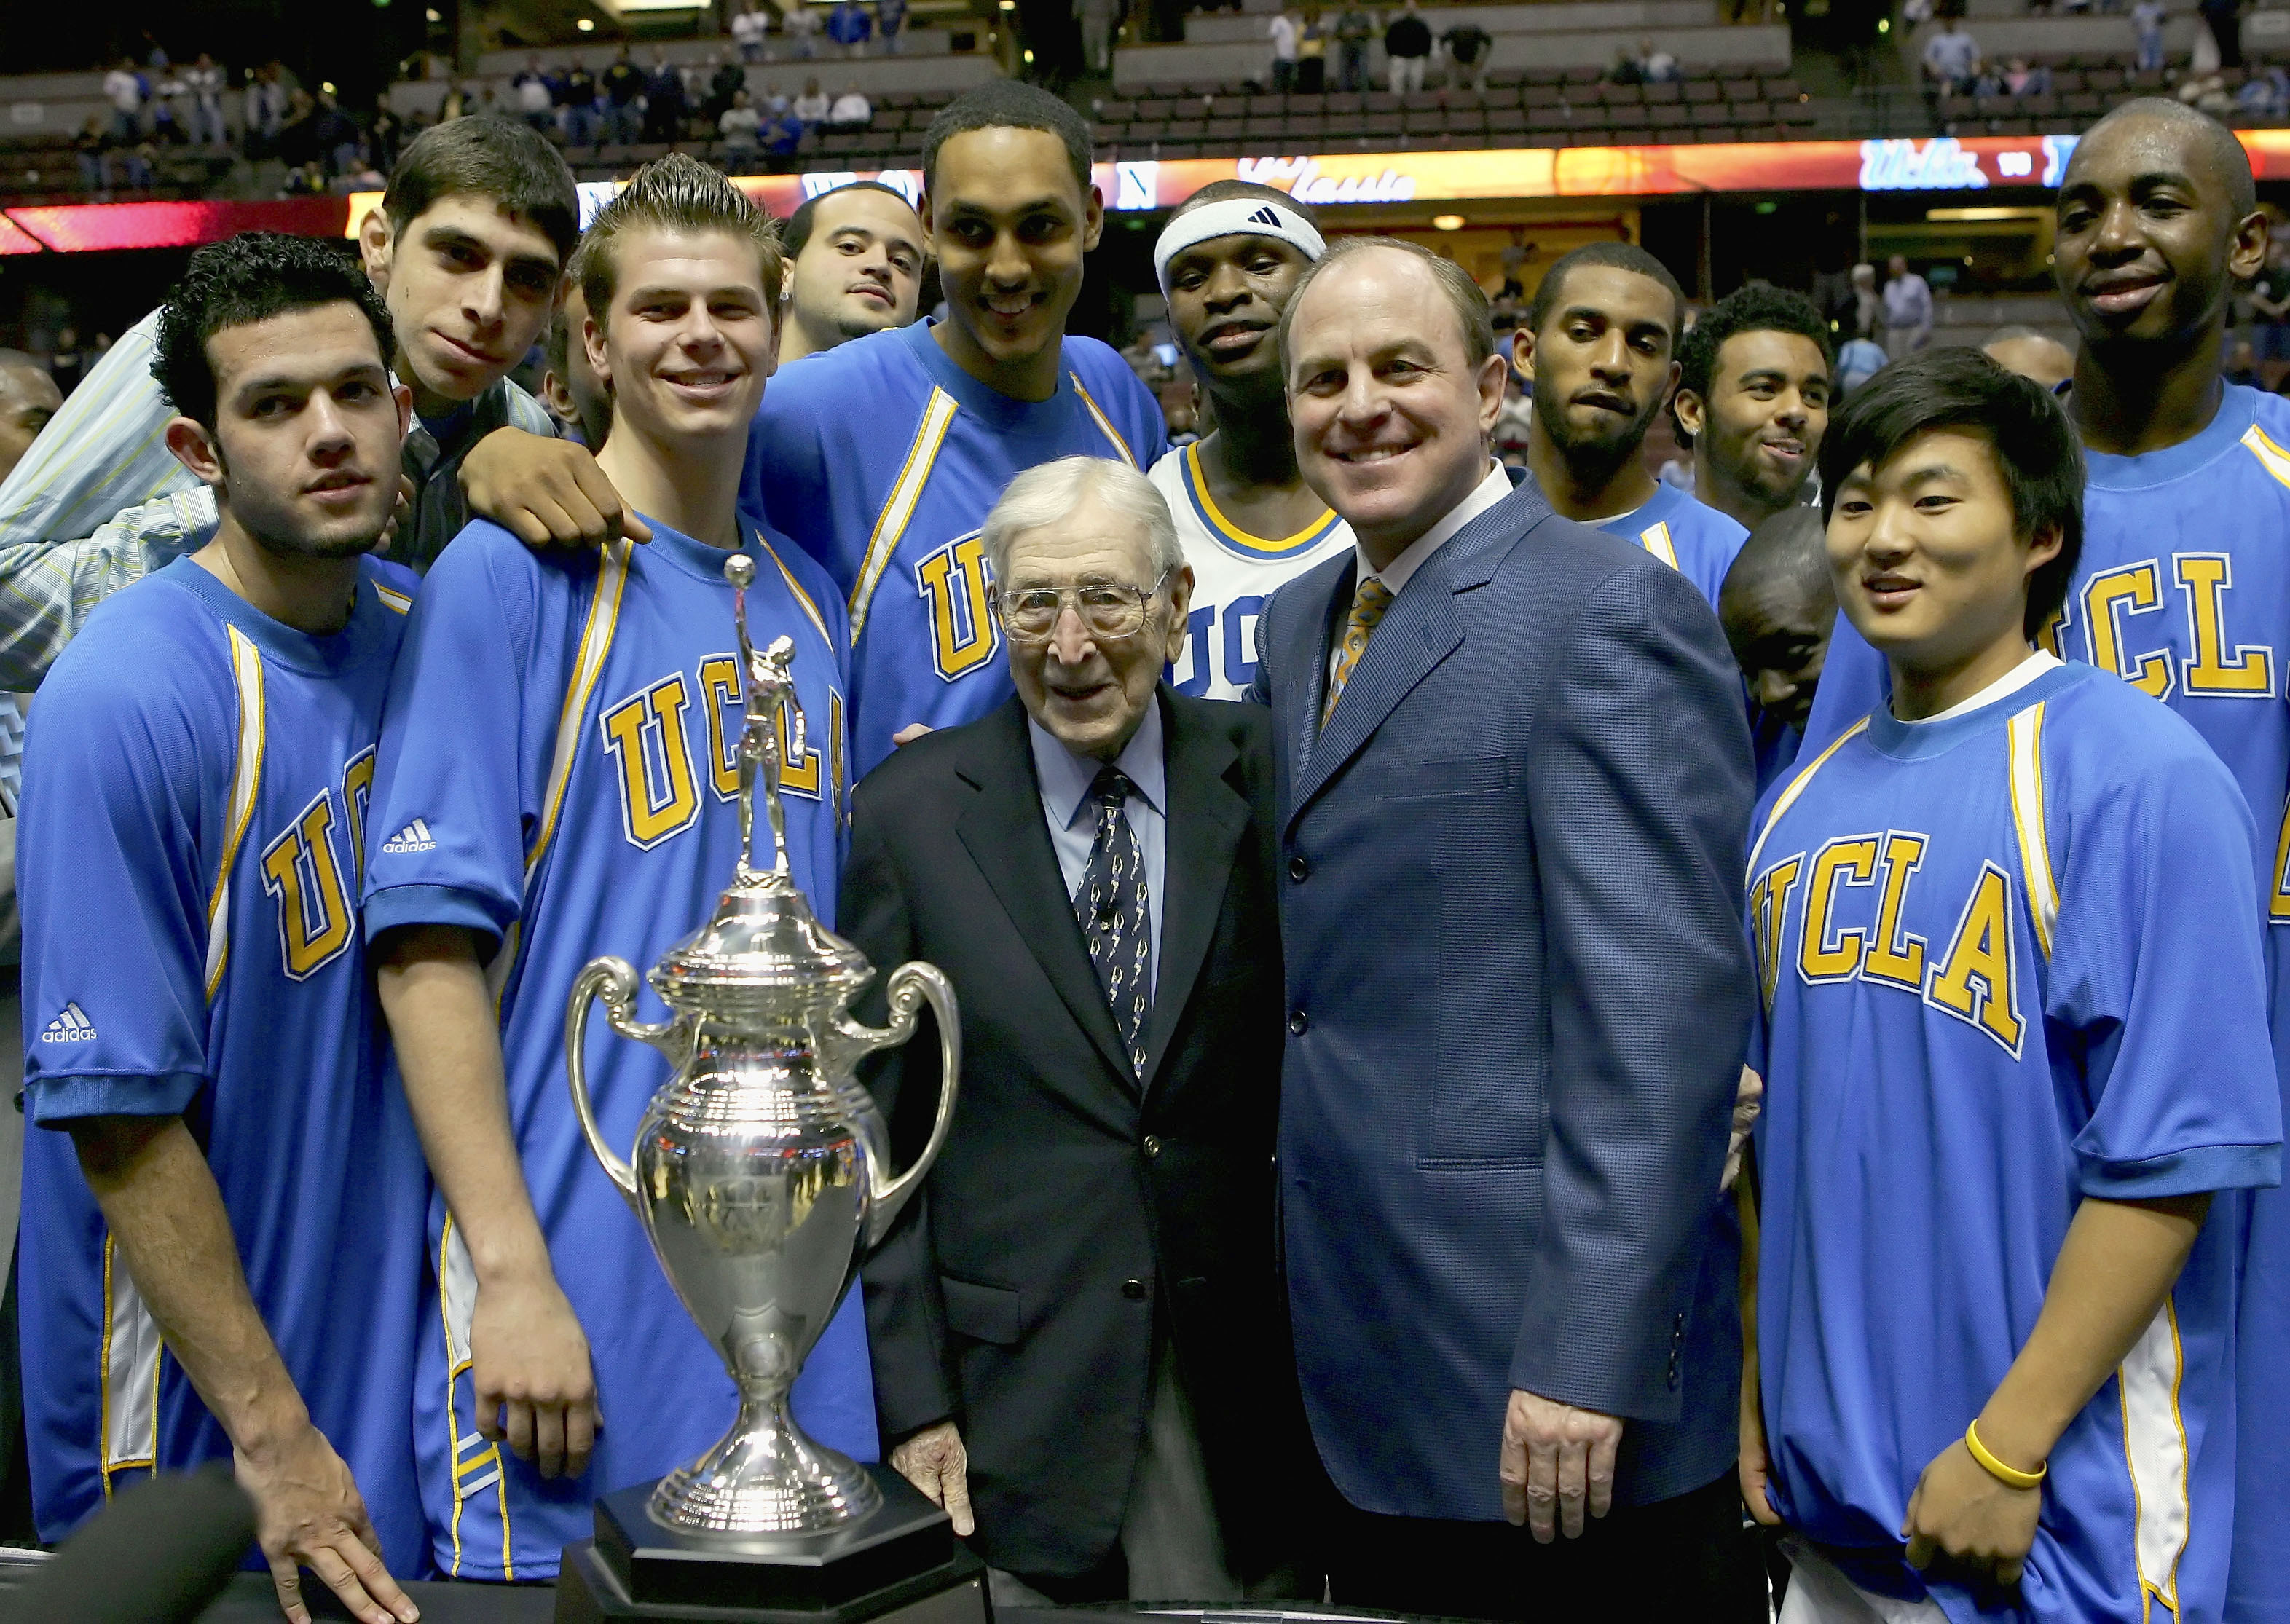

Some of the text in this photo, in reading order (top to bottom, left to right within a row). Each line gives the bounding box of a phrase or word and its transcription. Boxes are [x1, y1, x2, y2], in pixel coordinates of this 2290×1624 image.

[382, 840, 436, 854] adidas
[1749, 829, 2026, 1062] UCLA
[42, 1026, 98, 1043] adidas
